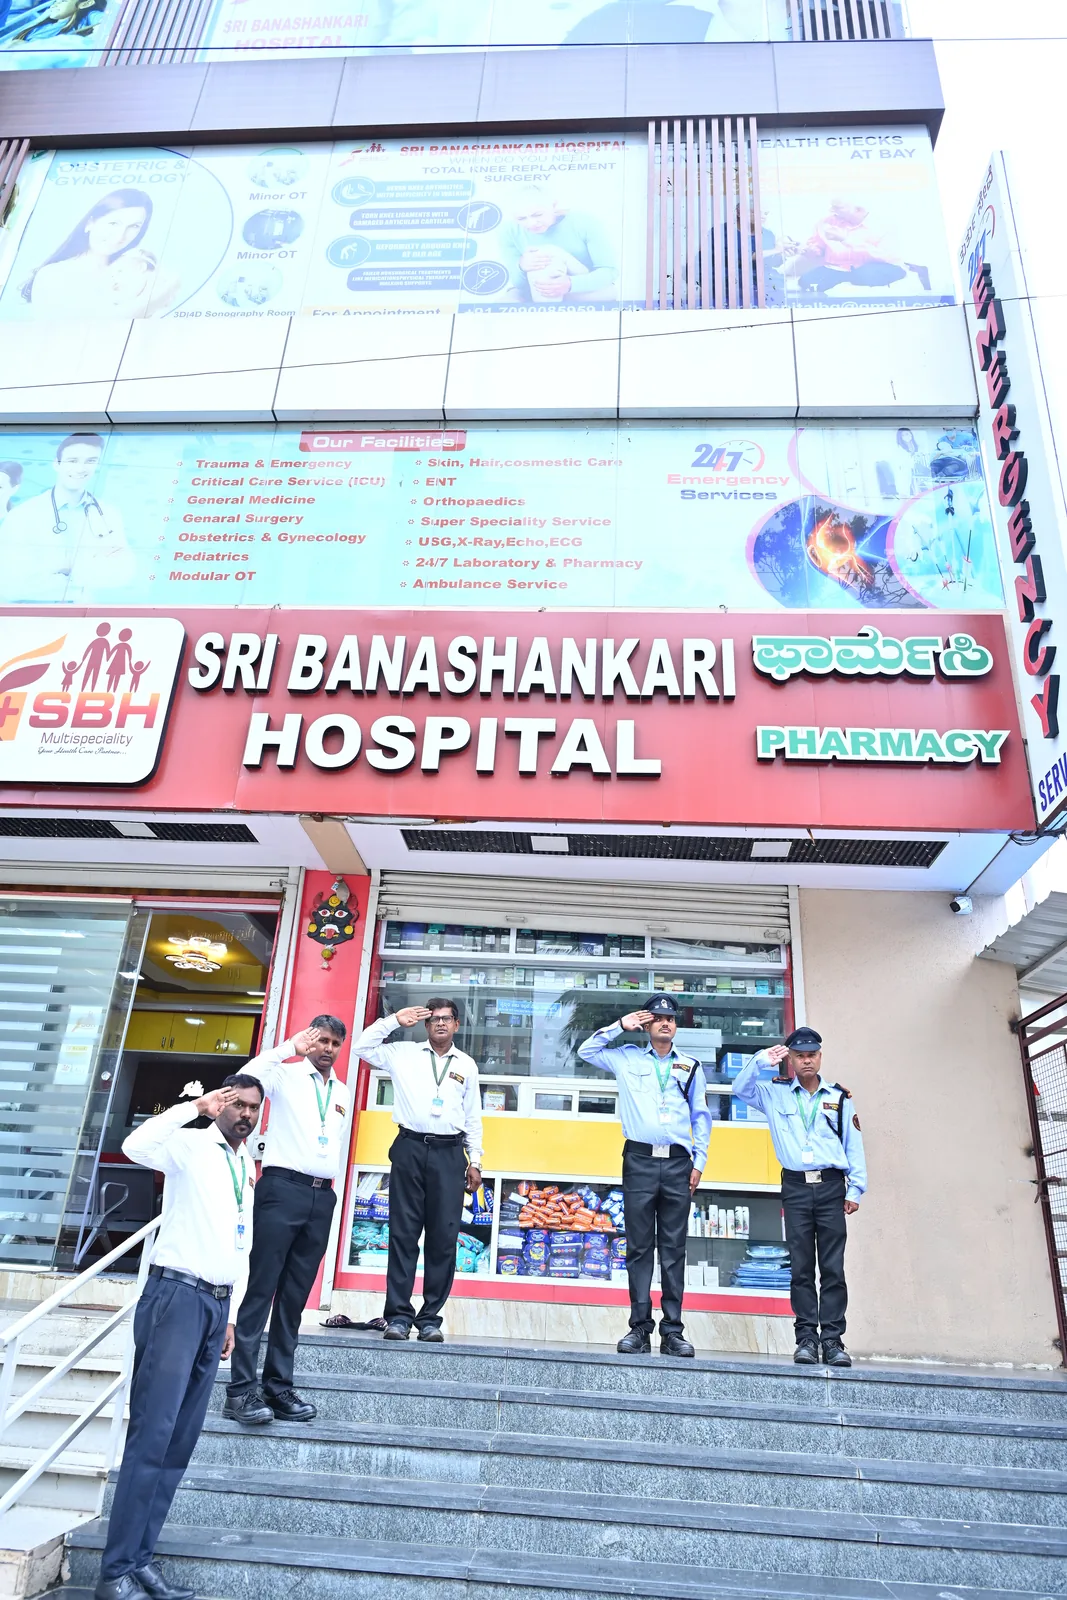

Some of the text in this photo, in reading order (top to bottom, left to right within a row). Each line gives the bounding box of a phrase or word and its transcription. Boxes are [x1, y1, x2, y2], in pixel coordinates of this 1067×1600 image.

[223, 14, 369, 34] SRI BANASHANKARI
[234, 35, 347, 52] HOSPITAL
[825, 134, 904, 147] CHECKS
[400, 146, 424, 157] SRI
[429, 143, 550, 156] BANASHANKARI
[850, 148, 916, 160] AT BAY
[449, 152, 590, 164] WHEN DO YOU NEED
[59, 159, 187, 173] OBSTETRIC &
[421, 162, 617, 175] TOTAL KNEE REPLACEMENT
[54, 172, 191, 186] GYNECOLOGY
[483, 173, 551, 183] SURGERY
[248, 191, 308, 201] Minor OT
[236, 250, 298, 260] Minor OT
[204, 310, 264, 319] Sonography
[266, 309, 296, 317] Room
[312, 434, 454, 449] Our Facilities
[196, 459, 352, 470] Trauma & Emergency
[427, 457, 463, 469] Skin,
[587, 457, 623, 467] Care
[191, 477, 244, 487] Critical
[248, 477, 283, 487] Care
[287, 476, 343, 486] Service
[425, 478, 457, 487] ENT
[667, 474, 790, 488] Emergency
[187, 495, 316, 505] General Medicine
[680, 489, 778, 500] Services
[972, 262, 1059, 739] EMERGENCY
[423, 497, 526, 508] Orthopaedics
[182, 513, 304, 526] Genaral Surgery
[420, 516, 612, 529] Super Speciality Service
[178, 532, 367, 545] Obstetrics & Gynecology
[418, 537, 583, 549] USG,X-Ray,Echo,ECG
[173, 551, 250, 562] Pediatrics
[415, 558, 643, 570] 24/7 Laboratory & Pharmacy
[168, 571, 257, 581] Modular OT
[412, 579, 568, 589] Ambulance Service
[188, 631, 736, 700] SRI BANASHANKARI
[28, 691, 160, 729] SBH
[40, 732, 134, 747] Multispeciality
[243, 712, 662, 778] HOSPITAL
[756, 725, 1011, 766] PHARMACY
[54, 746, 77, 755] Health
[78, 746, 93, 754] Care
